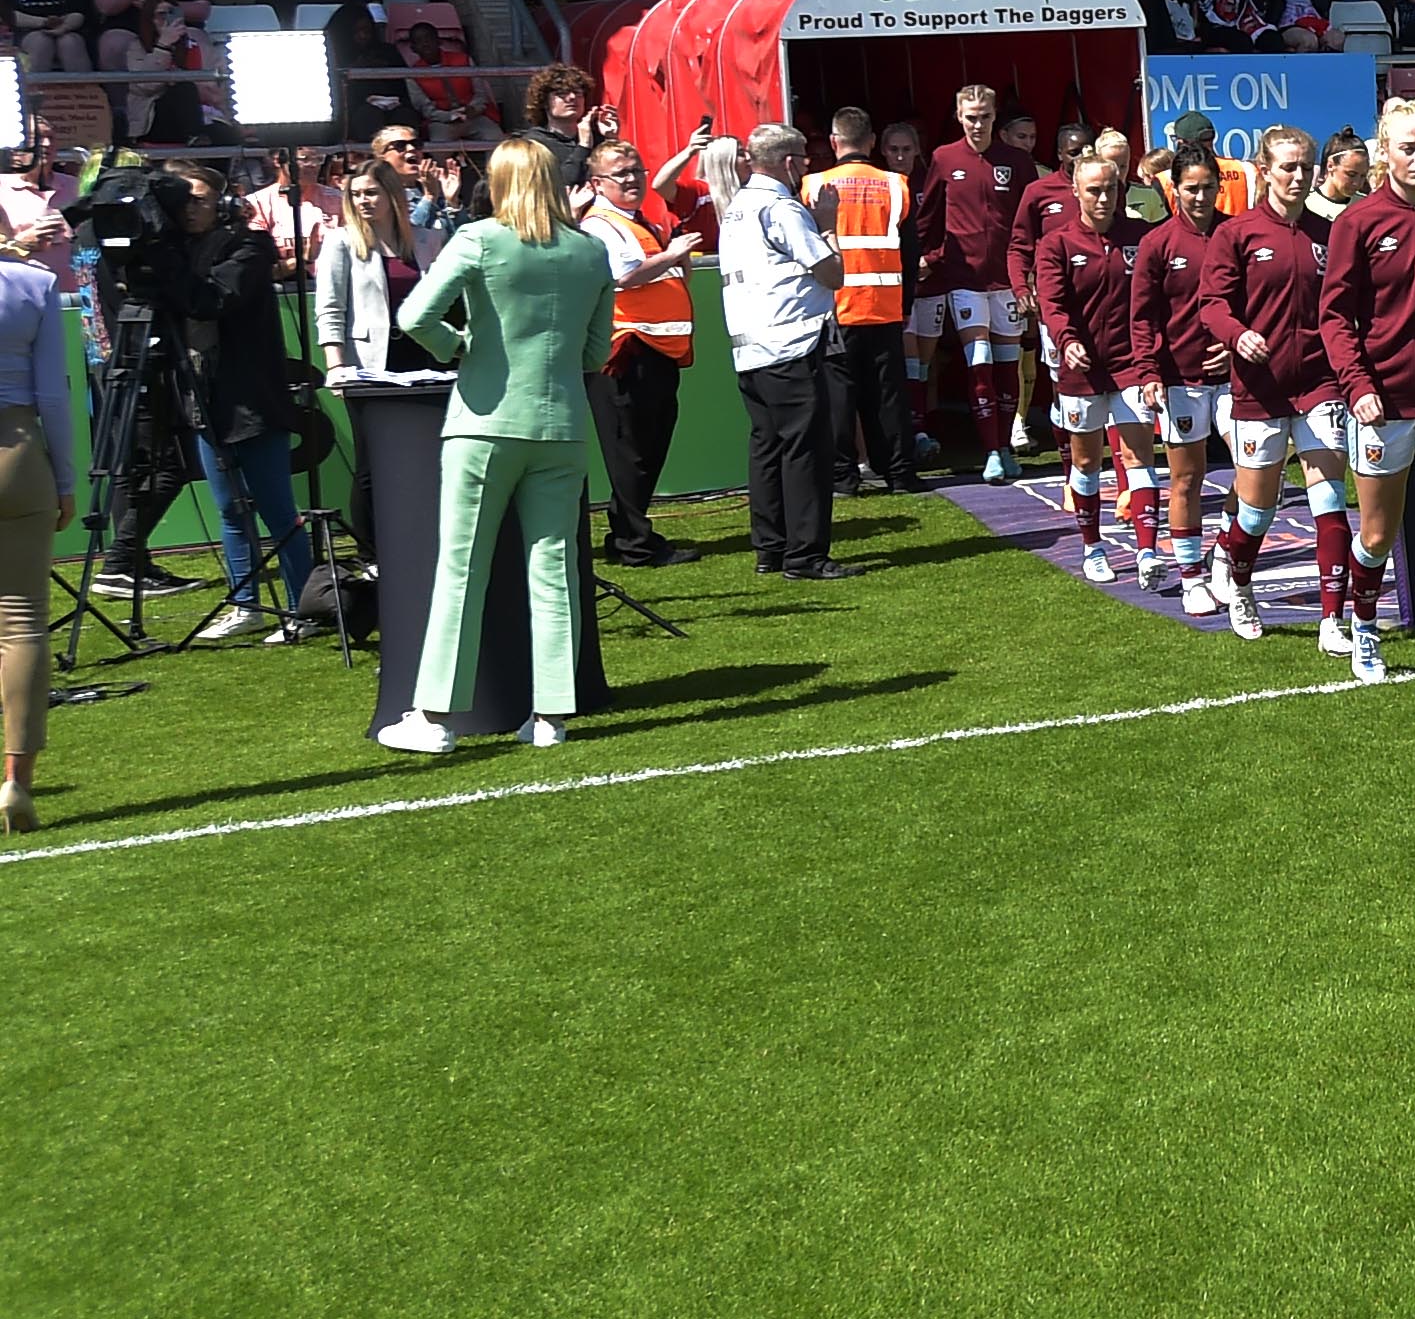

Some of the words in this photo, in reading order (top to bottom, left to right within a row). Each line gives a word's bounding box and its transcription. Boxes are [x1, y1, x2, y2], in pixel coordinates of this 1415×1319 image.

[798, 13, 863, 31] Proud
[870, 11, 896, 29] To
[903, 8, 989, 29] Support
[994, 6, 1034, 24] The
[1041, 4, 1128, 25] Daggers
[1230, 72, 1289, 111] ON
[1325, 402, 1347, 429] 12
